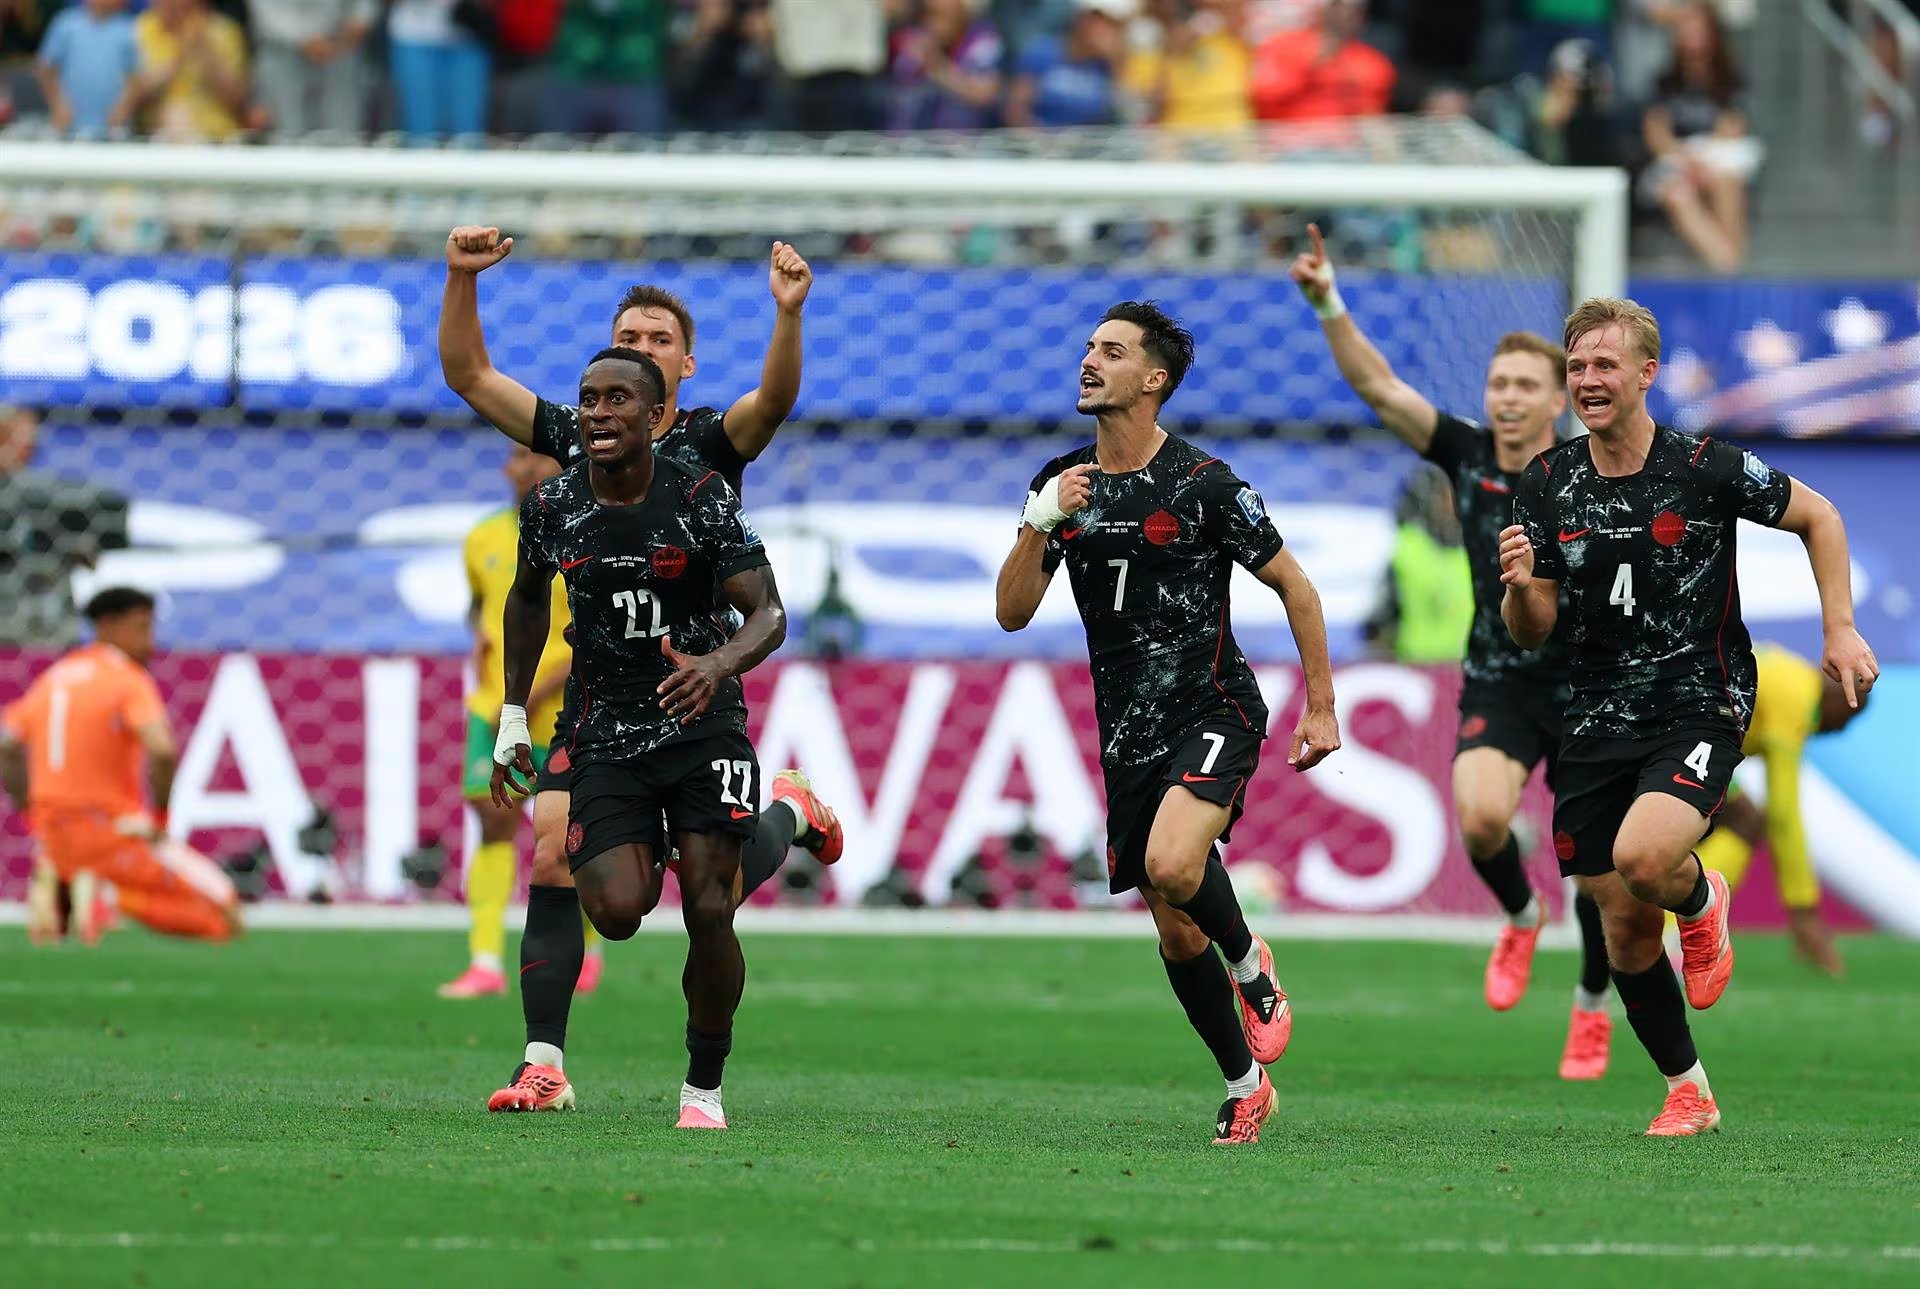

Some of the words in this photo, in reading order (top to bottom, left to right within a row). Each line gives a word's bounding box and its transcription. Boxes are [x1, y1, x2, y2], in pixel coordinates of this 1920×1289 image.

[1107, 559, 1128, 611] 7
[1609, 563, 1636, 616] 4
[612, 588, 670, 639] 22
[48, 684, 70, 774] 1
[1200, 732, 1225, 774] 7
[165, 652, 1448, 912] AIWAS
[711, 759, 753, 812] 22
[1684, 741, 1712, 781] 4
